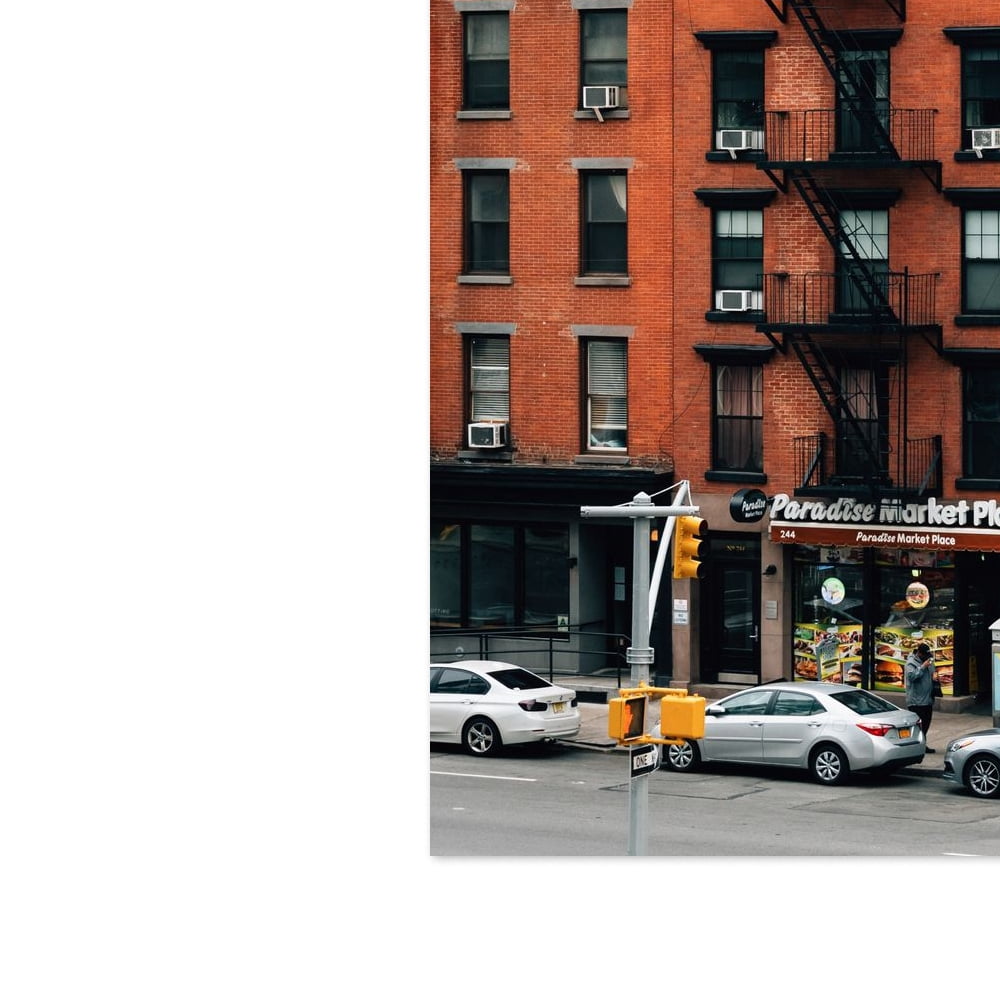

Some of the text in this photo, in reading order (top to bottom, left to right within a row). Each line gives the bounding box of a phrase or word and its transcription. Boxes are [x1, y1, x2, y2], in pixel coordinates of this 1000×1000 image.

[741, 498, 766, 512] Paradise
[769, 493, 877, 522] Paradise
[879, 497, 970, 526] Market
[780, 530, 796, 539] 244
[856, 531, 956, 546] Paradise Market Place
[635, 754, 648, 767] ONE
